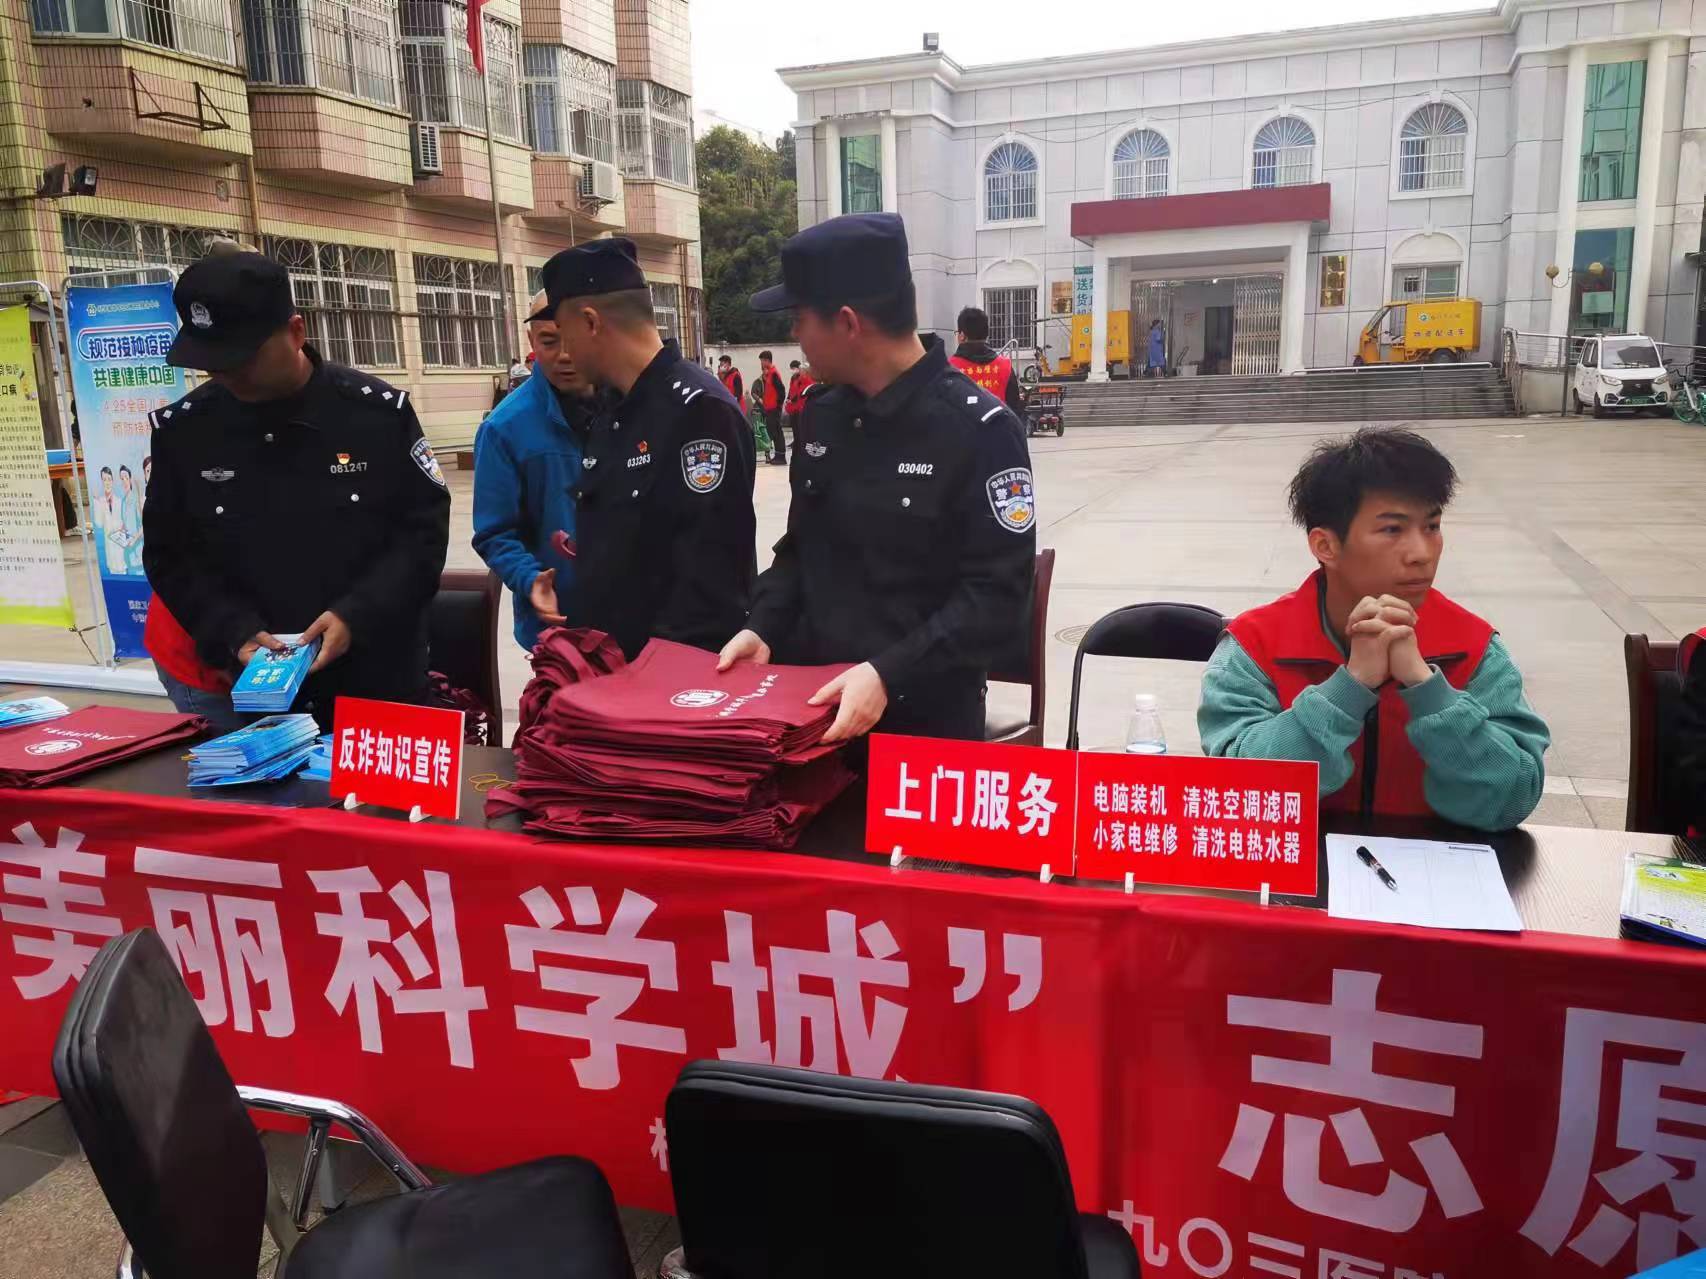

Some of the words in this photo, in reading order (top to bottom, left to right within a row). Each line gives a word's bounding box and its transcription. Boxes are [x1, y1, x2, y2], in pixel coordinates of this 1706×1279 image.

[0, 384, 18, 396] 口病
[93, 364, 175, 389] 共建健康中国
[330, 462, 368, 474] 081247
[898, 463, 933, 475] 030402
[338, 726, 452, 789] 反诈知识宣传
[884, 762, 1058, 836] 上门服务
[1093, 781, 1167, 816] 电脑装机
[1183, 786, 1301, 824] 清洗空调滤网
[1093, 820, 1178, 855] 小家电维修
[1192, 826, 1300, 864] 清洗电热水器
